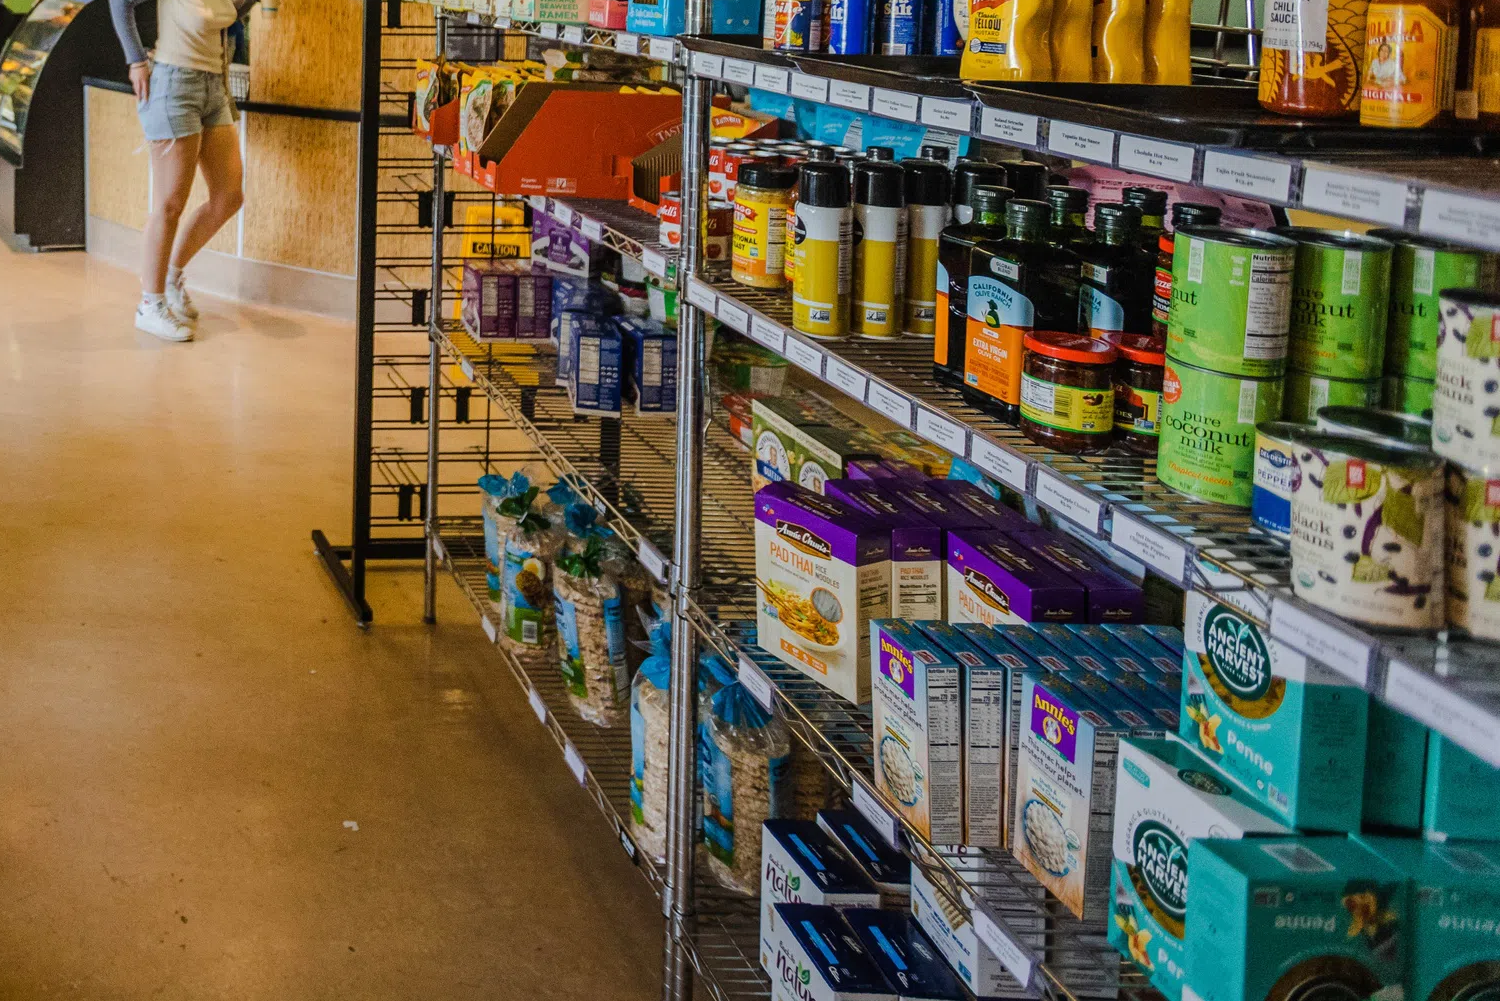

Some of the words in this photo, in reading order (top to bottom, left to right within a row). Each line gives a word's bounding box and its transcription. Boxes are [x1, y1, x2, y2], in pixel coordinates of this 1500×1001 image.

[540, 10, 578, 19] RAMEN
[884, 4, 912, 16] Salt
[1270, 12, 1298, 24] SAUCE
[975, 18, 1001, 31] YELLOW
[1361, 89, 1413, 101] RIGINAL
[1087, 137, 1100, 145] Sauce
[1134, 149, 1153, 157] Cholula
[1163, 154, 1178, 162] Sauce
[1093, 179, 1123, 187] PREMIUM
[1231, 169, 1245, 177] Fruit
[996, 262, 1014, 271] GLOBAL
[1253, 254, 1285, 262] Nutrition
[997, 267, 1011, 275] BLEND
[973, 283, 1013, 303] CALIFORNIA
[975, 290, 992, 299] OLIVE
[992, 293, 1012, 310] RANCH
[973, 337, 989, 351] EXTRA
[989, 342, 1008, 359] VIRGIN
[977, 349, 993, 359] OLIVE
[1183, 410, 1221, 428] pure
[1166, 415, 1250, 447] coconut
[1180, 435, 1223, 456] milk
[1269, 451, 1291, 465] DESTI
[1168, 461, 1201, 479] Tropical
[1203, 475, 1233, 487] nectar
[1258, 469, 1292, 487] PEPPER
[1054, 488, 1074, 504] Pineapple
[1074, 500, 1090, 514] Chunks
[777, 523, 802, 542] Annie
[802, 532, 830, 553] Chun's
[770, 540, 790, 563] PAD
[790, 549, 813, 577] THAI
[1151, 546, 1170, 560] Peppers
[815, 563, 827, 574] RICE
[901, 567, 910, 575] PAD
[815, 570, 840, 590] NOODLES
[964, 570, 986, 592] Annie
[984, 582, 1009, 607] Chun's
[958, 590, 975, 616] PAD
[974, 604, 995, 628] THAI
[1197, 600, 1210, 643] ORGANIC
[1209, 622, 1265, 670] ANCIENT
[881, 638, 913, 675] Annie's
[1208, 637, 1264, 686] HARVEST
[891, 698, 902, 712] our
[903, 707, 923, 730] planet.
[899, 697, 916, 716] helps
[1034, 694, 1076, 736] Annie's
[1028, 736, 1041, 750] This
[1041, 748, 1055, 763] mac
[1055, 757, 1076, 781] helps
[1227, 729, 1274, 776] Penne
[1021, 742, 1044, 764] protect
[1044, 762, 1057, 776] our
[1057, 771, 1085, 798] planet.
[1126, 818, 1139, 854] ORGANIC
[1142, 807, 1173, 827] GLUTEN
[1138, 838, 1188, 886] ANCIEN
[1137, 849, 1188, 902] HARVES
